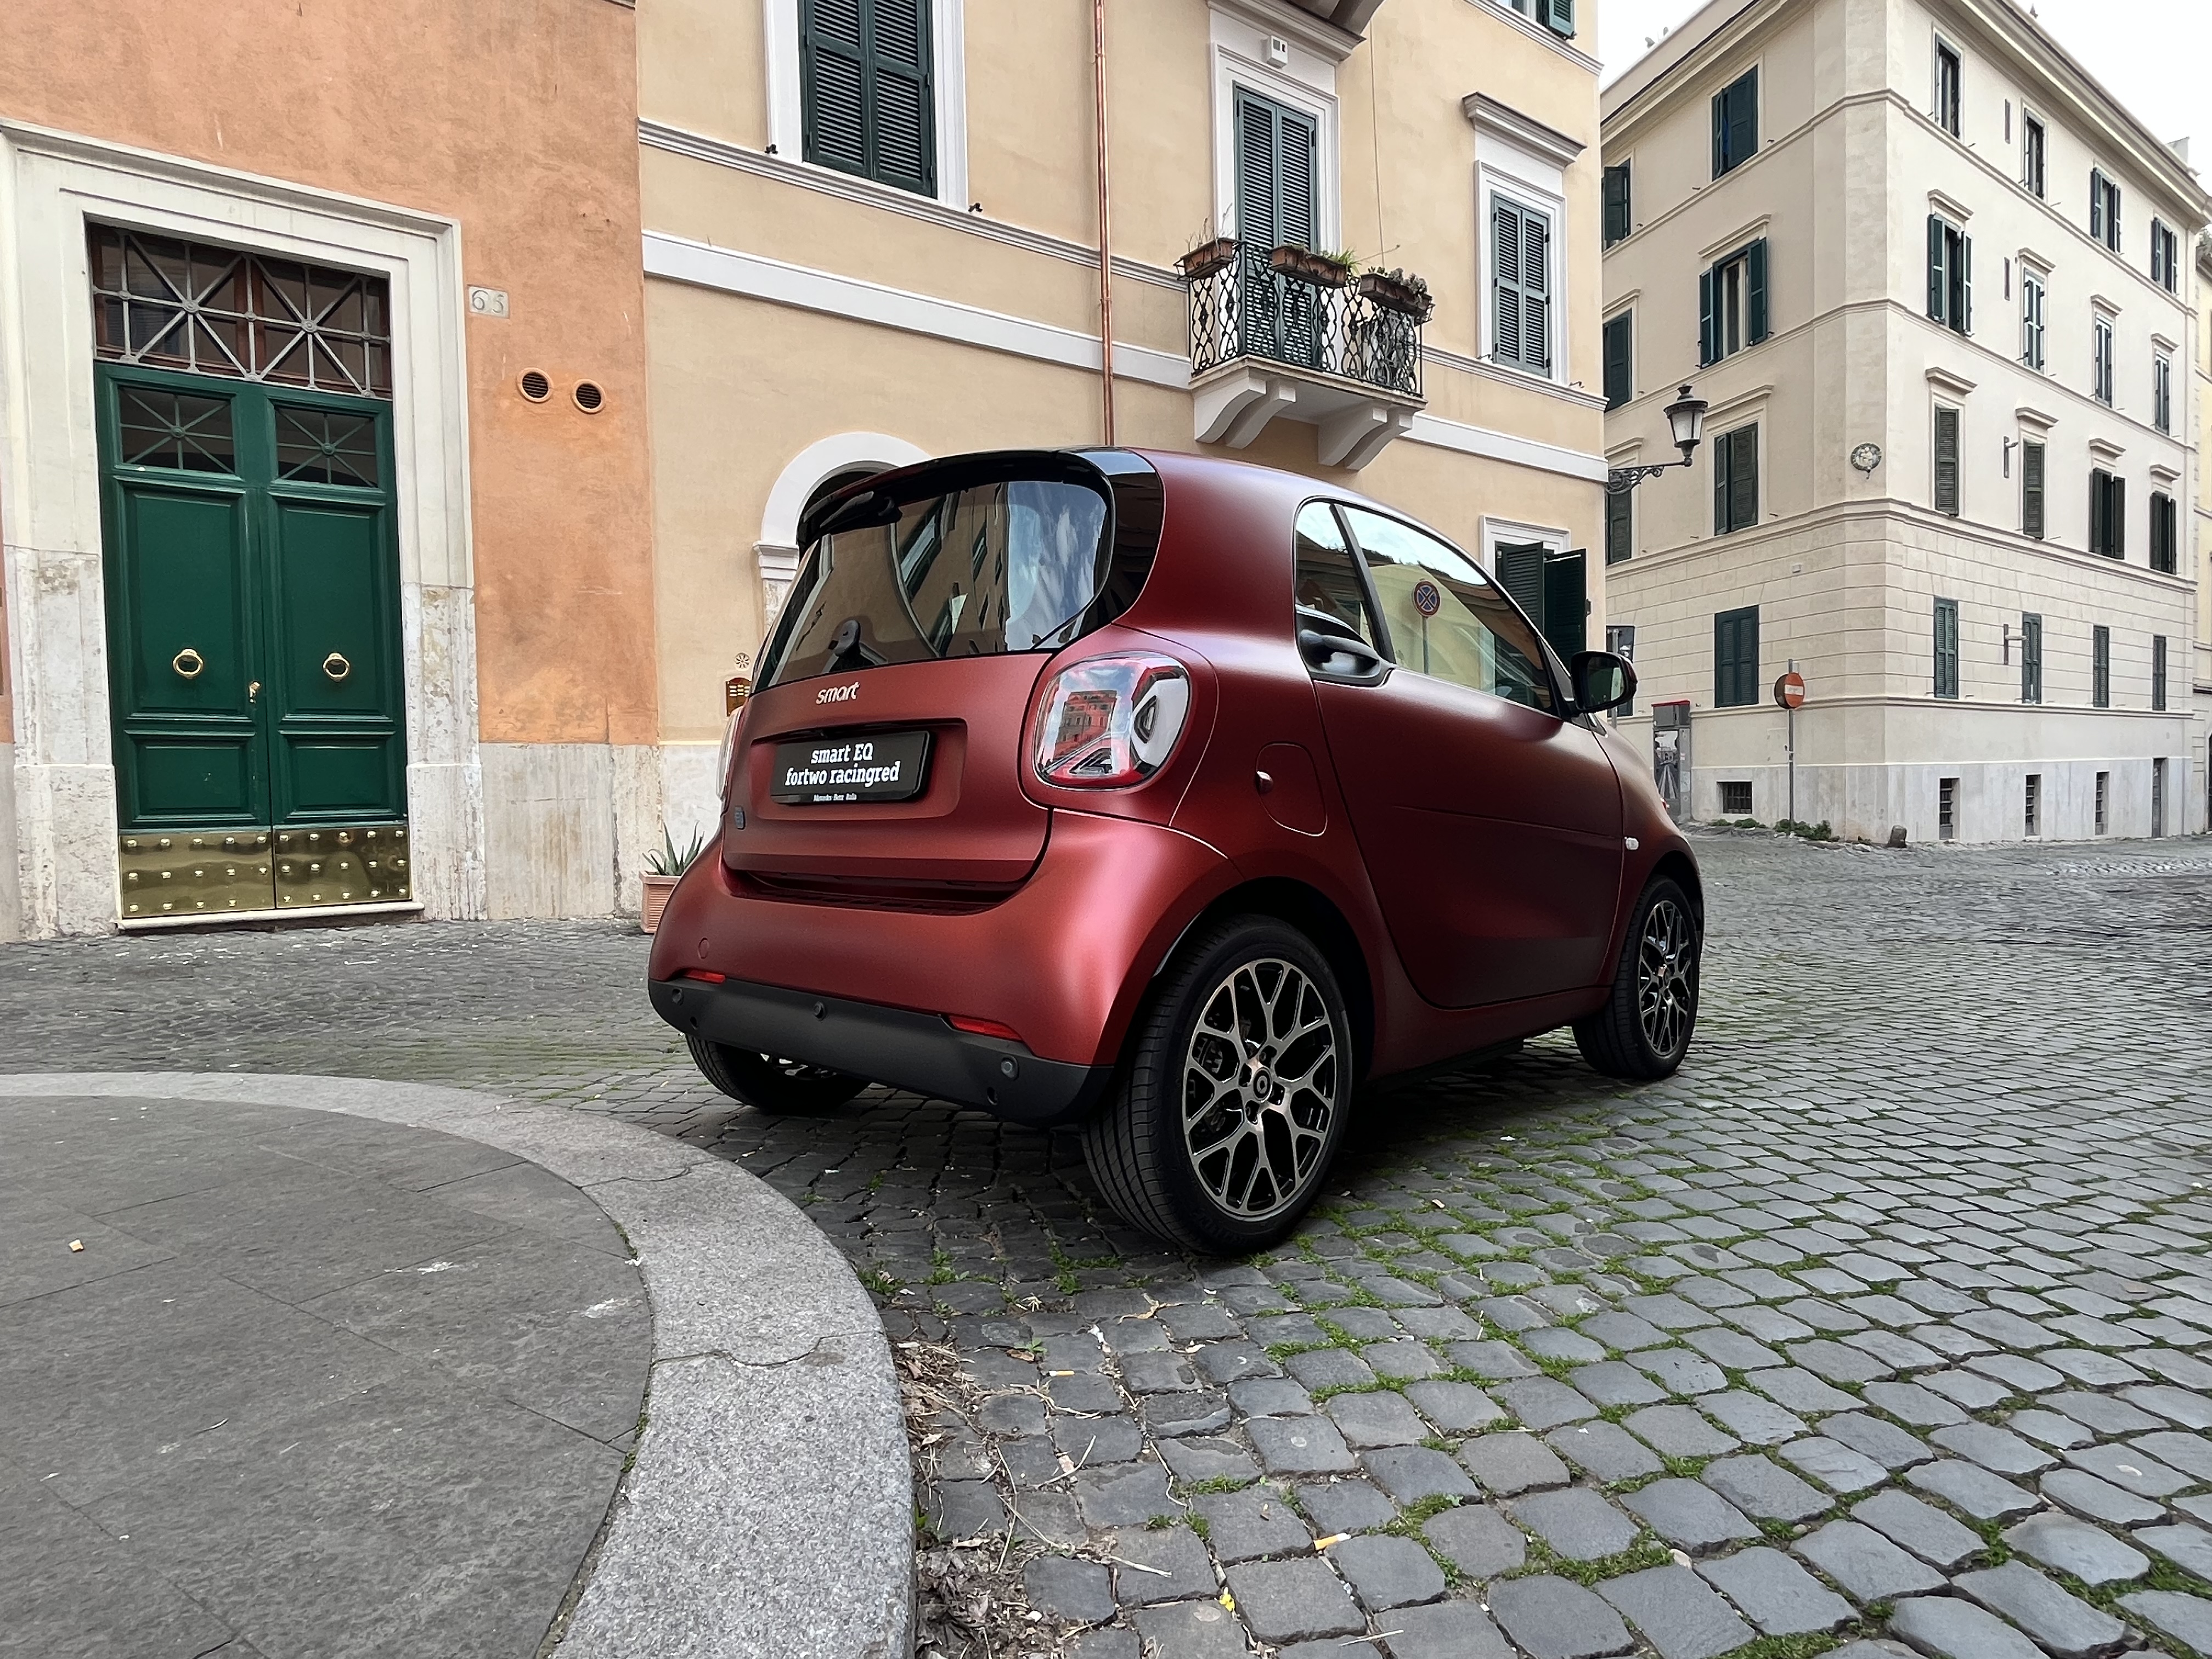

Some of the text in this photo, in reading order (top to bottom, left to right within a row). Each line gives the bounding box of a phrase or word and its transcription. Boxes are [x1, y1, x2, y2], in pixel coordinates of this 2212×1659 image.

[815, 681, 860, 704] smart
[811, 743, 873, 764] smart EQ
[785, 761, 901, 787] fortwo racingred
